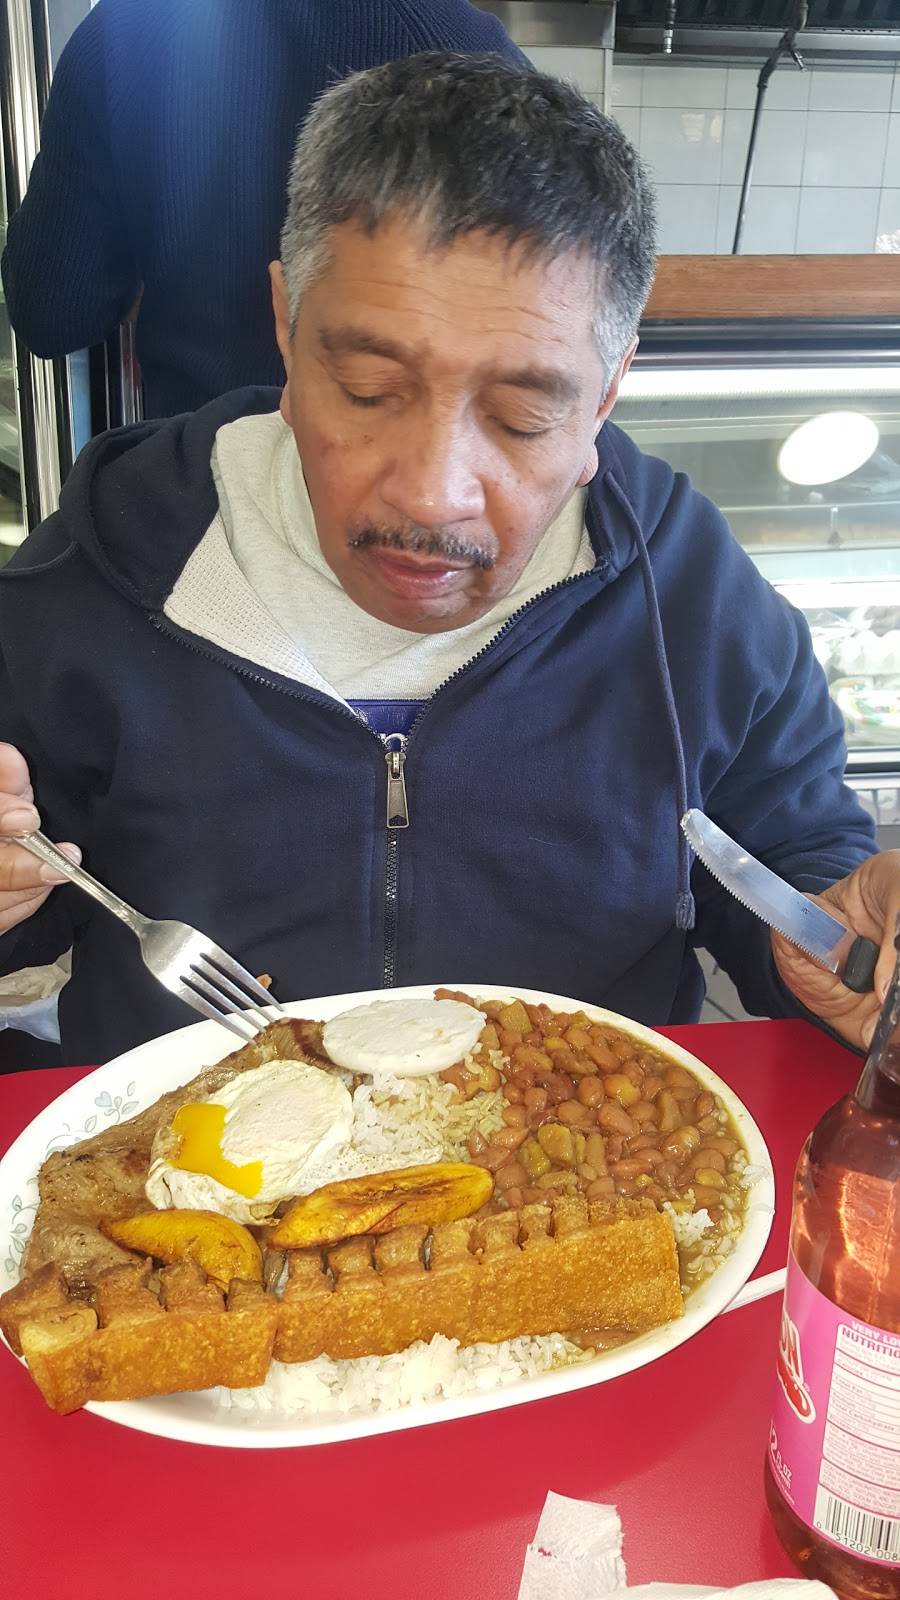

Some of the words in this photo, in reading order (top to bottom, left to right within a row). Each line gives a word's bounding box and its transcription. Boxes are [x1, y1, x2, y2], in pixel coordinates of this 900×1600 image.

[851, 1320, 880, 1339] VERY
[882, 1334, 900, 1346] LO
[836, 1532, 871, 1555] 51202
